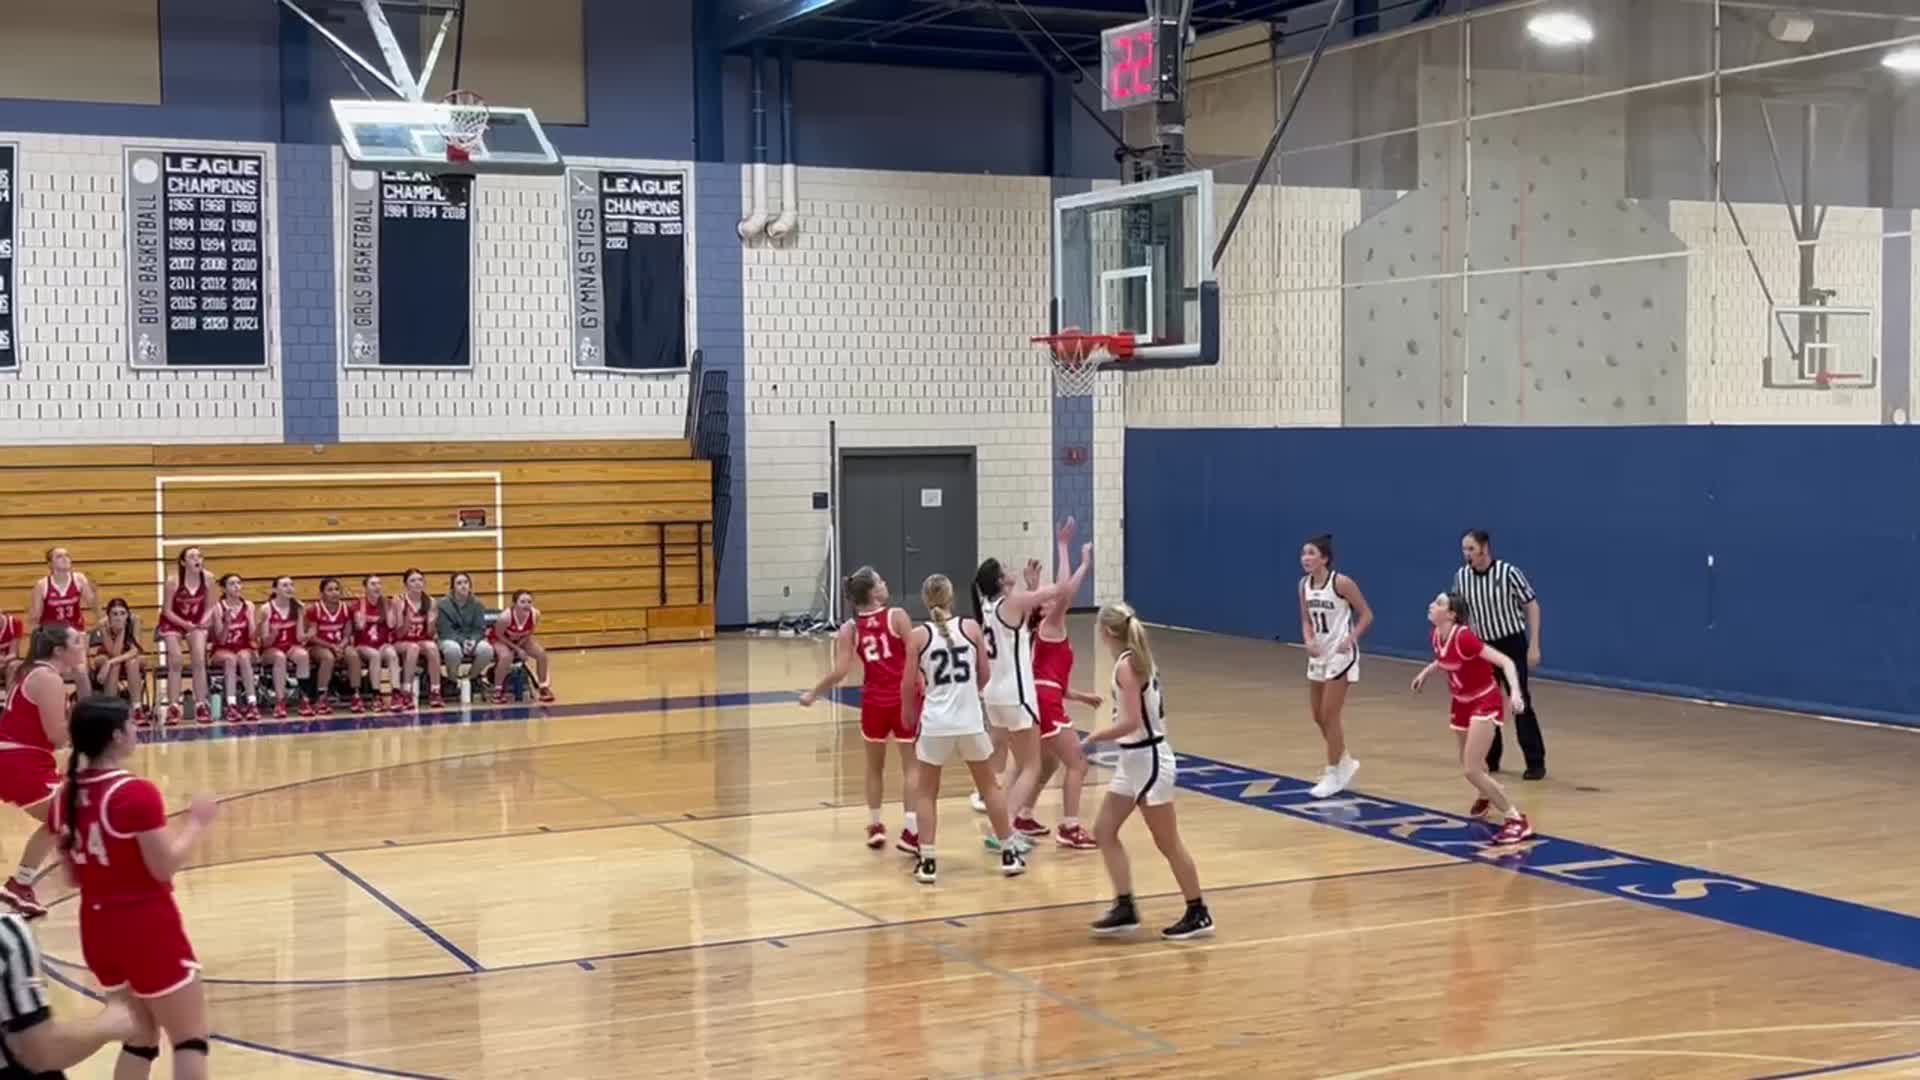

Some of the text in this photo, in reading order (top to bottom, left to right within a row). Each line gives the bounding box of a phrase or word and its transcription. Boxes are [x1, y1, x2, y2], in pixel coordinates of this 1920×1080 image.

[1109, 30, 1153, 98] 22
[165, 156, 259, 176] LEAGUE
[168, 177, 257, 194] CHAMPIONS
[602, 177, 681, 195] LEAGUE
[605, 198, 680, 216] CHAMPIONS
[136, 194, 159, 325] BOYS BASKETBALL
[353, 199, 373, 327] GIRLS BASKETBALL
[576, 207, 599, 329] GYMNASTICS
[169, 276, 257, 291] 2011 2012 2014
[170, 295, 197, 310] 2015
[54, 605, 74, 621] 33
[1312, 611, 1329, 633] 11
[862, 633, 893, 663] 21
[928, 645, 971, 687] 25
